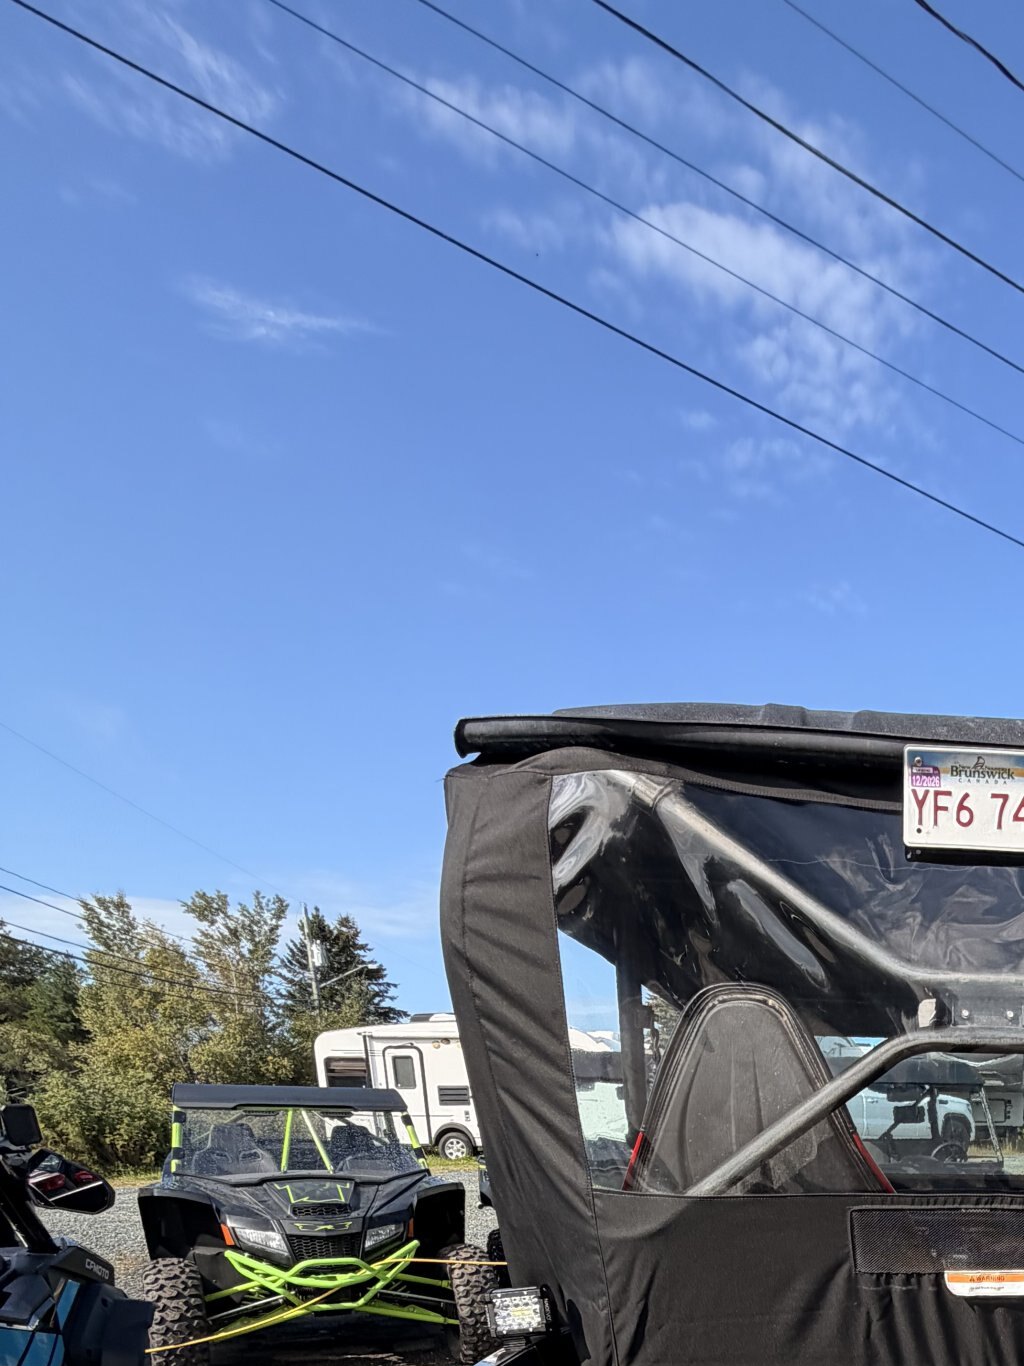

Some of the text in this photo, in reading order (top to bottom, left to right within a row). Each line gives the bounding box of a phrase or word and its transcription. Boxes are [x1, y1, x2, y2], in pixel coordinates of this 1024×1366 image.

[912, 775, 940, 787] 12/2026
[950, 765, 1015, 780] Brunswick
[911, 788, 975, 828] YF6
[85, 1258, 109, 1279] CFMOTO
